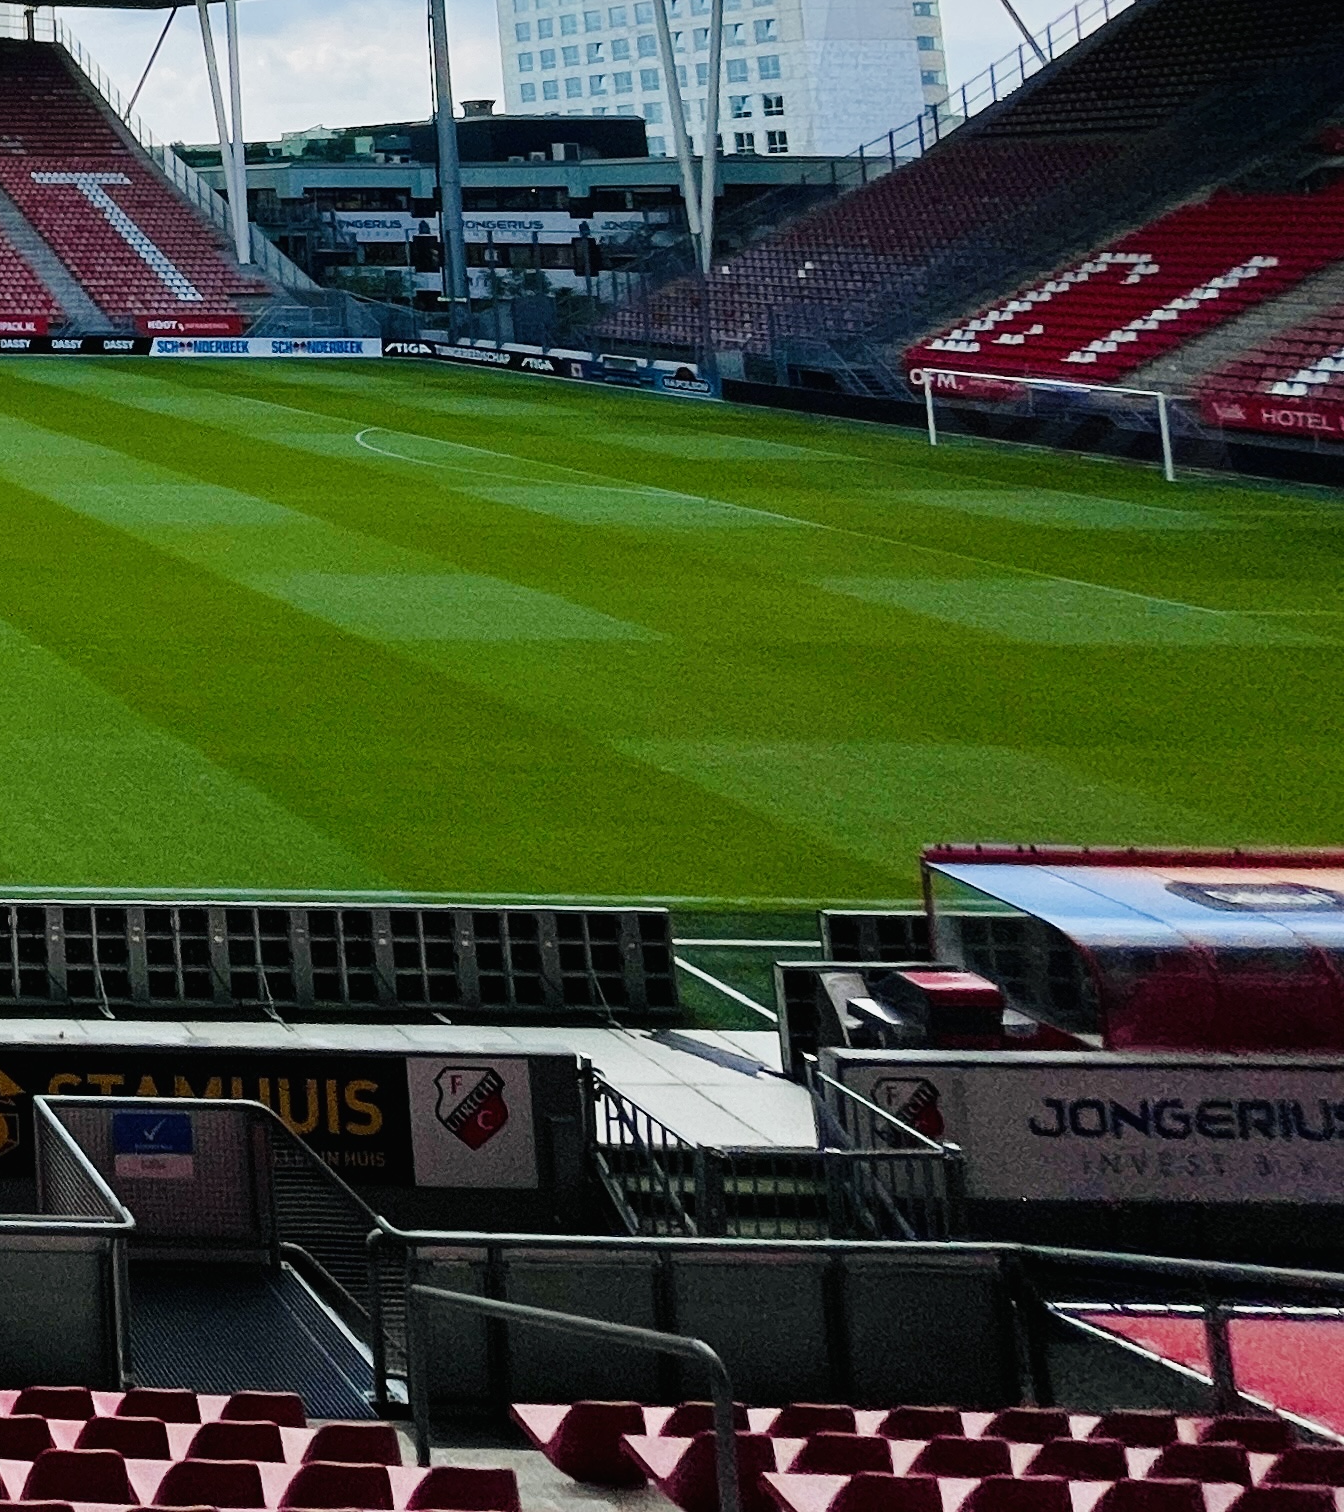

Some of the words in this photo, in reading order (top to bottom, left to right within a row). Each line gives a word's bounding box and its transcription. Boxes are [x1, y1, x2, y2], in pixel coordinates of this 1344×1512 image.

[0, 339, 32, 348] DASSY
[51, 340, 83, 349] DASSY
[103, 340, 135, 349] DASSY
[384, 342, 433, 354] STIGA
[1260, 408, 1336, 431] HOTEL
